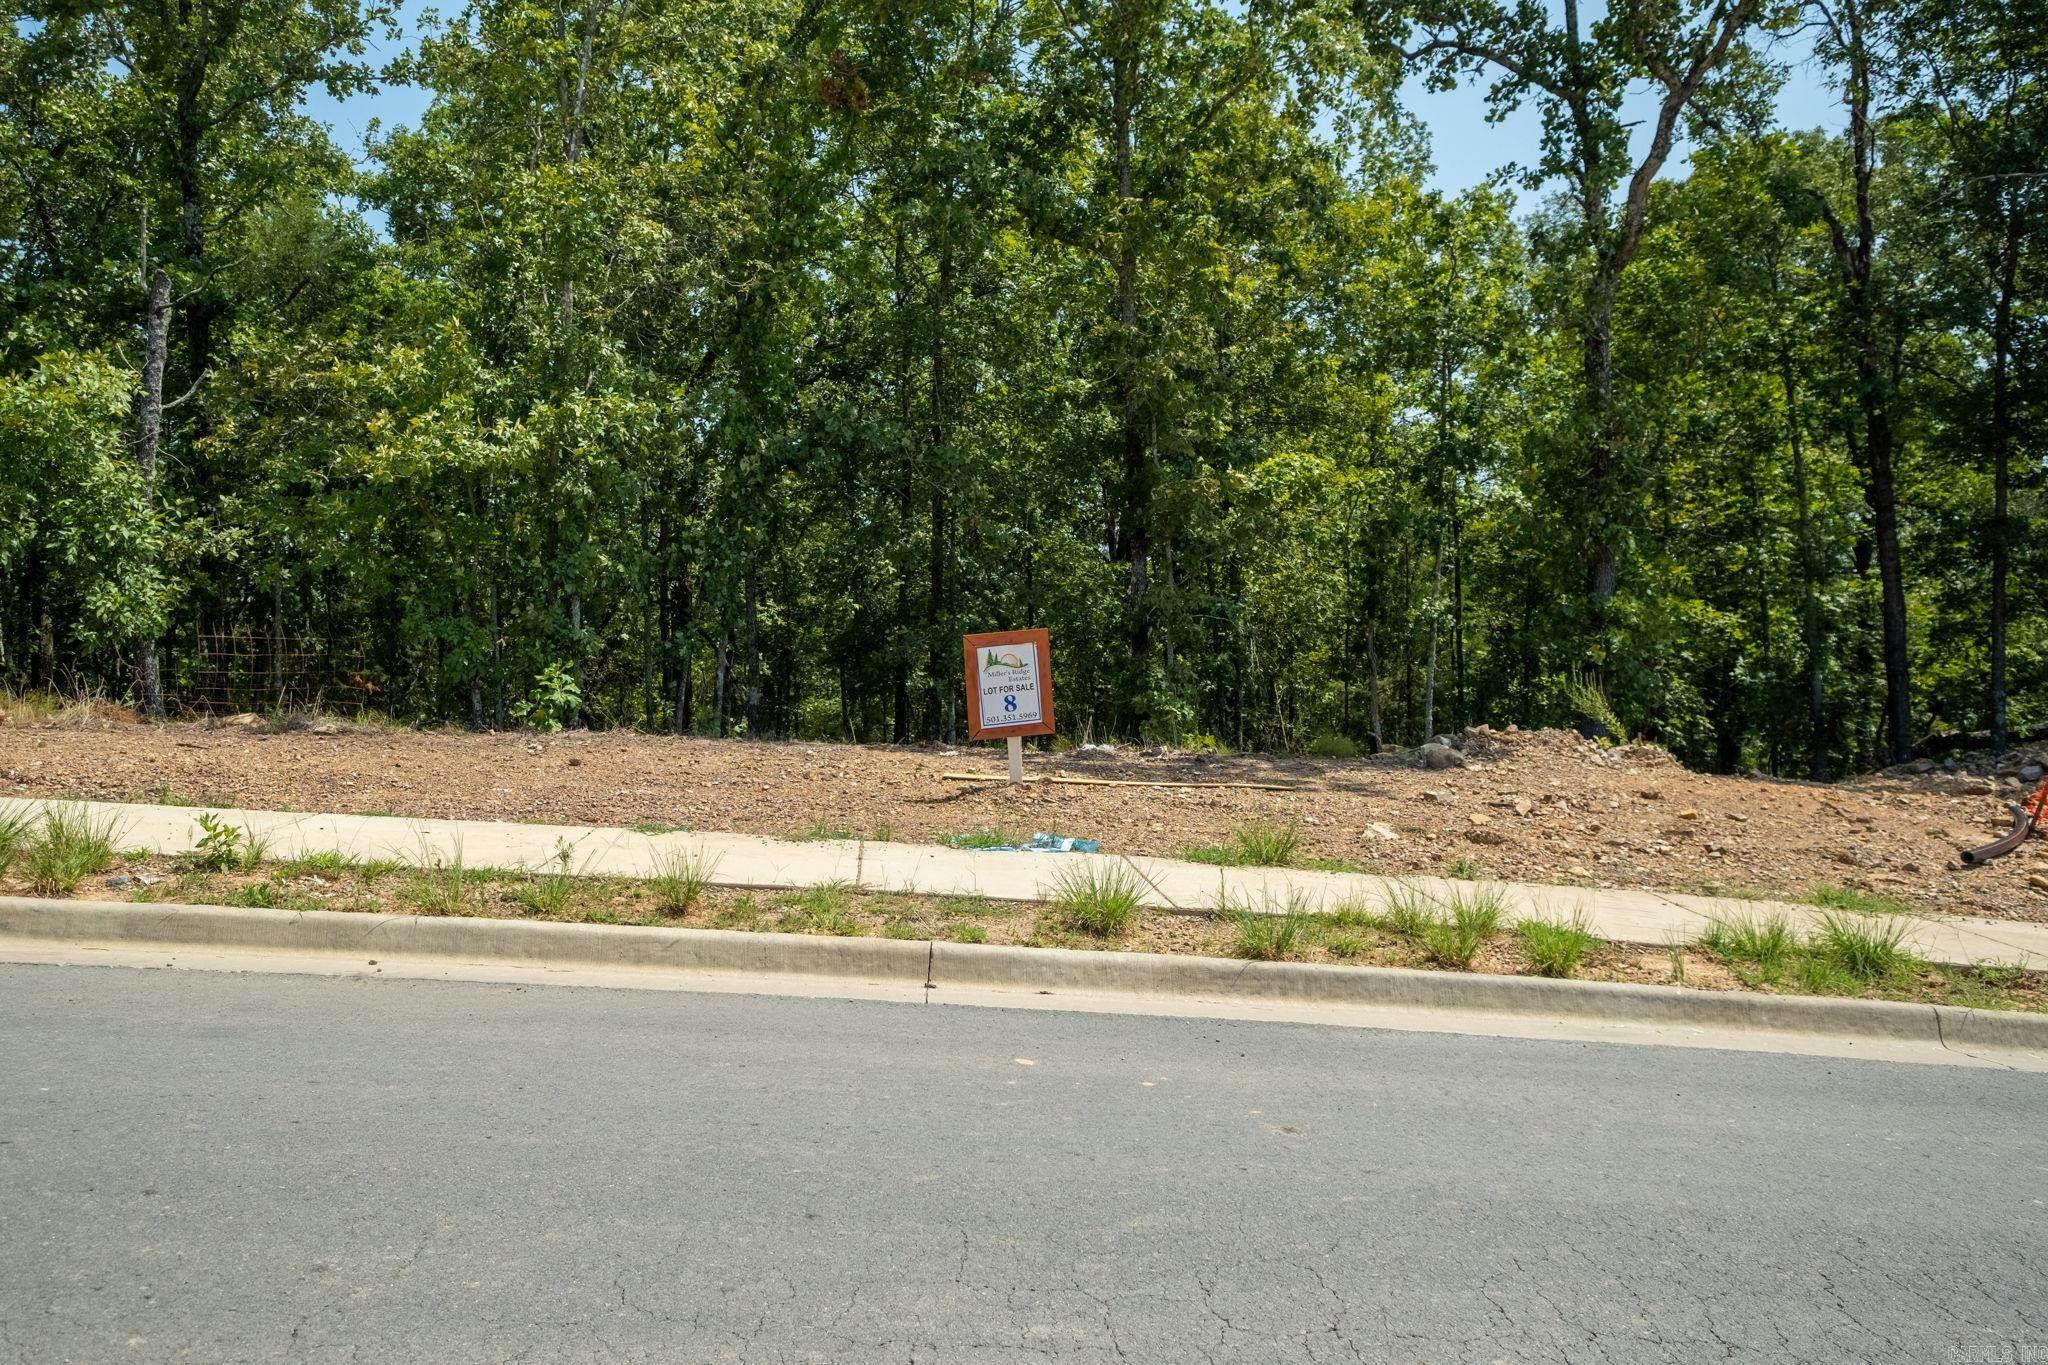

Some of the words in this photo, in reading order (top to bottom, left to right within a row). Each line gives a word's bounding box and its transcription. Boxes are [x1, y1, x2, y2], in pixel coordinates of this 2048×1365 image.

[983, 686, 998, 695] LOT
[999, 685, 1014, 693] FOR
[1016, 683, 1035, 692] SALE
[1004, 694, 1017, 712] 8
[986, 712, 1038, 723] 501.351.5969
